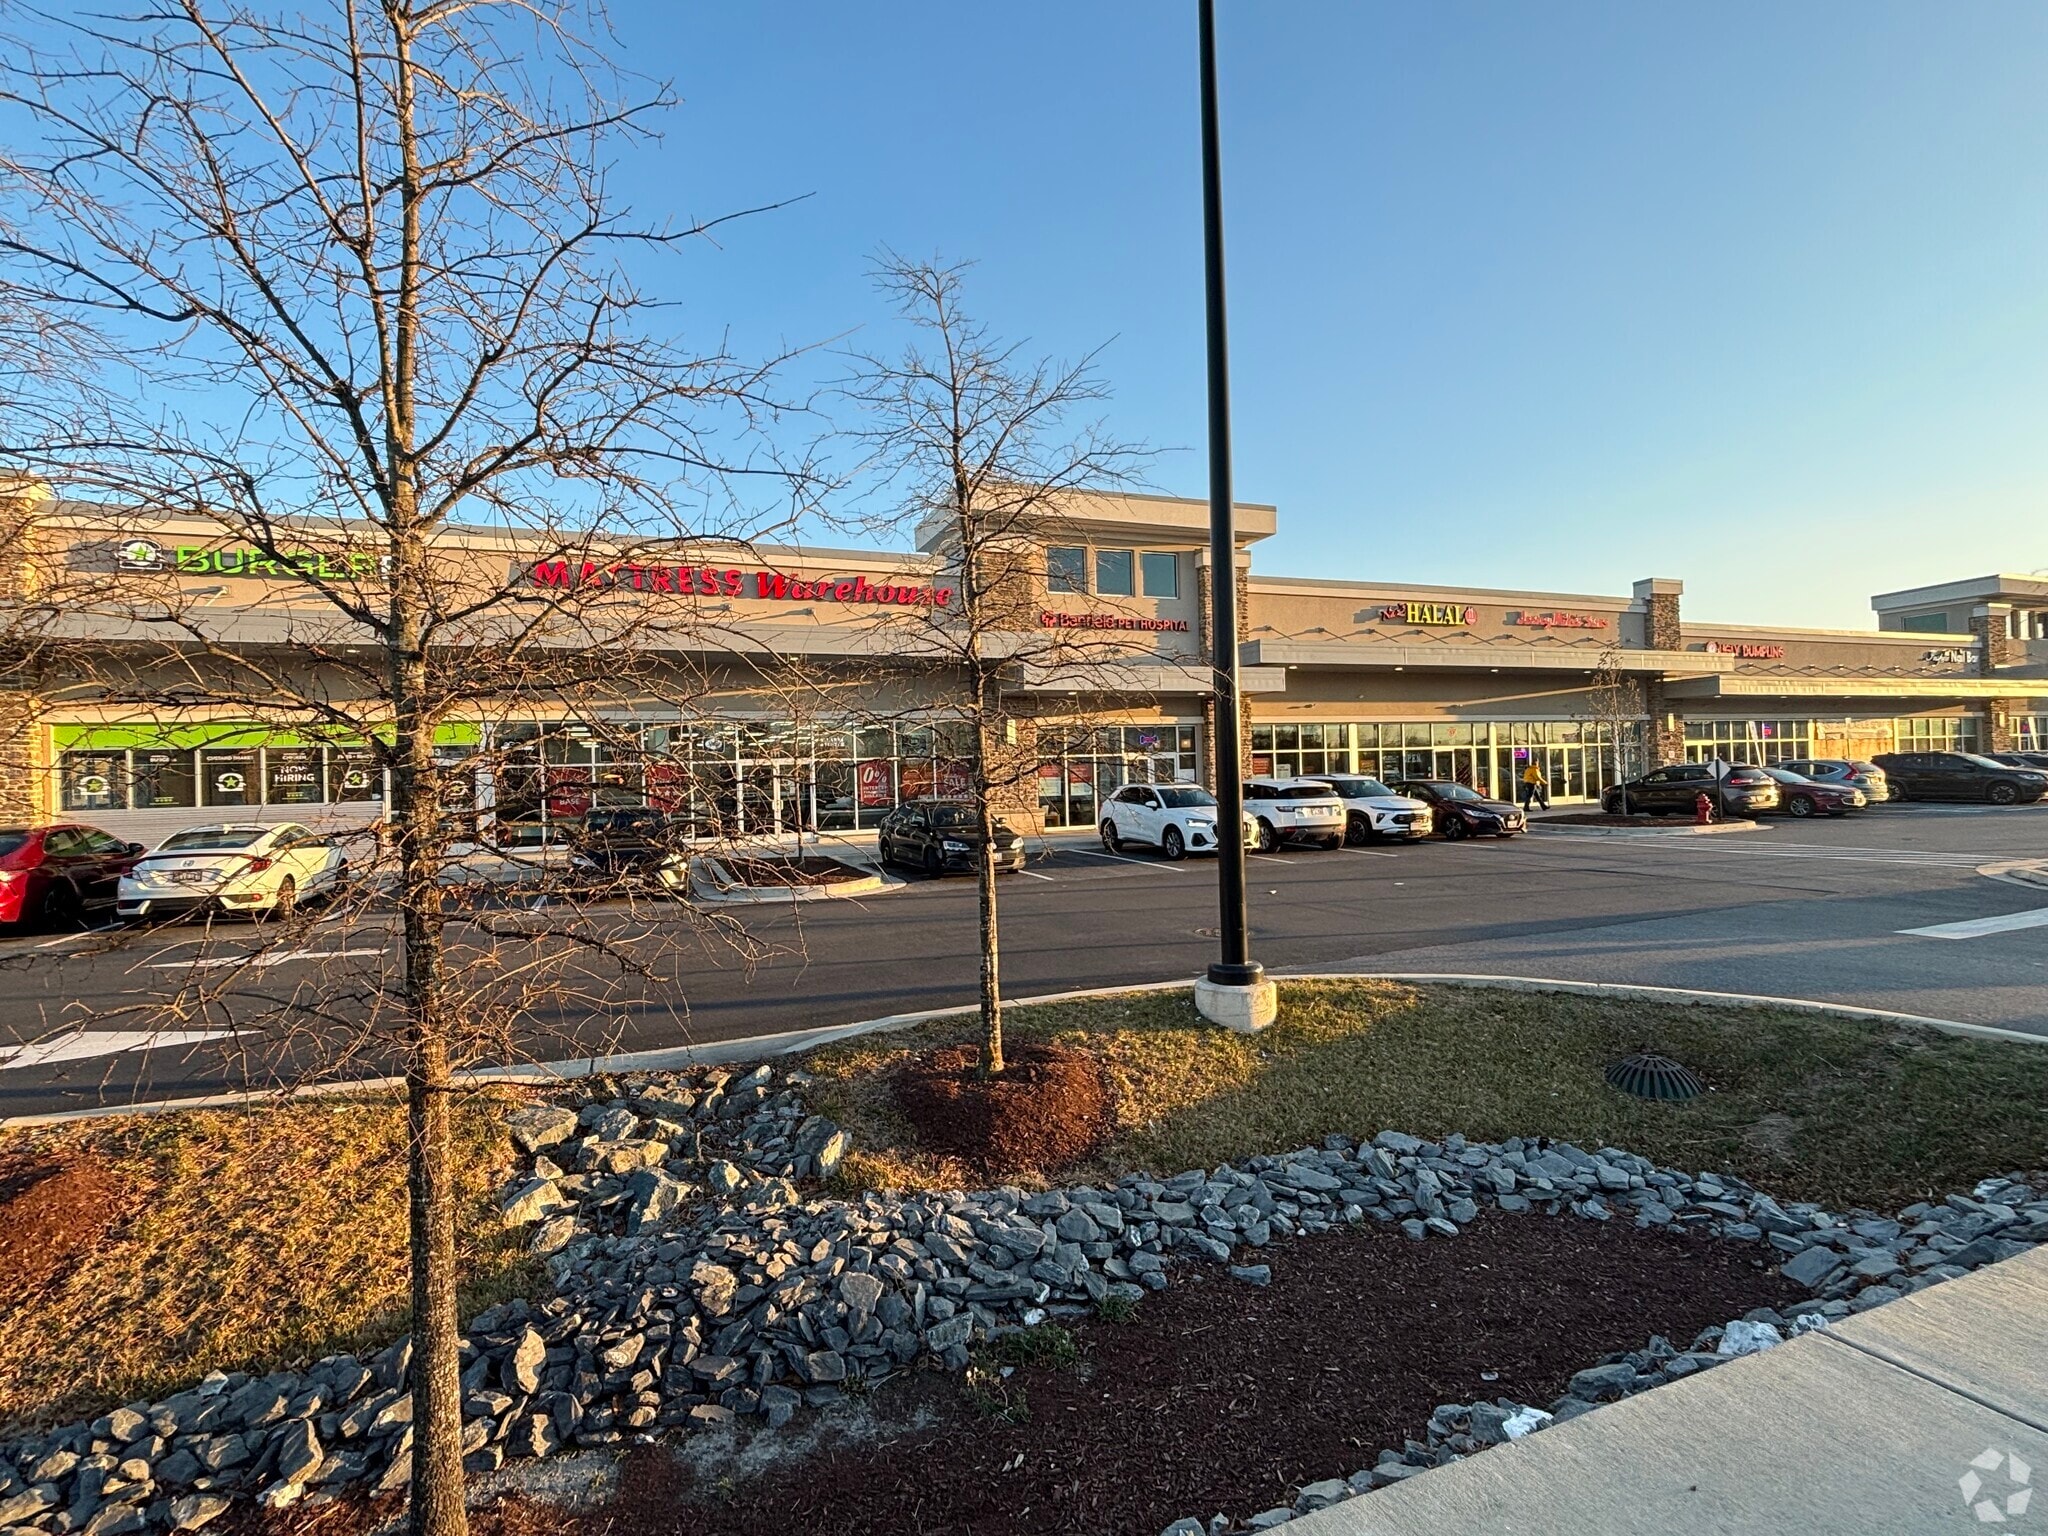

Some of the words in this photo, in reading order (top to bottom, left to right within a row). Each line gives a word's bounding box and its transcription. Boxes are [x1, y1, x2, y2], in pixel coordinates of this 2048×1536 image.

[757, 572, 953, 606] Warehouse
[1060, 612, 1114, 628] Banfield
[1118, 618, 1137, 629] PET
[1140, 619, 1190, 631] HOSPITAL
[1406, 602, 1465, 624] HALAL
[274, 773, 315, 783] HIRING
[863, 767, 887, 783] 0%
[943, 776, 966, 788] SALE
